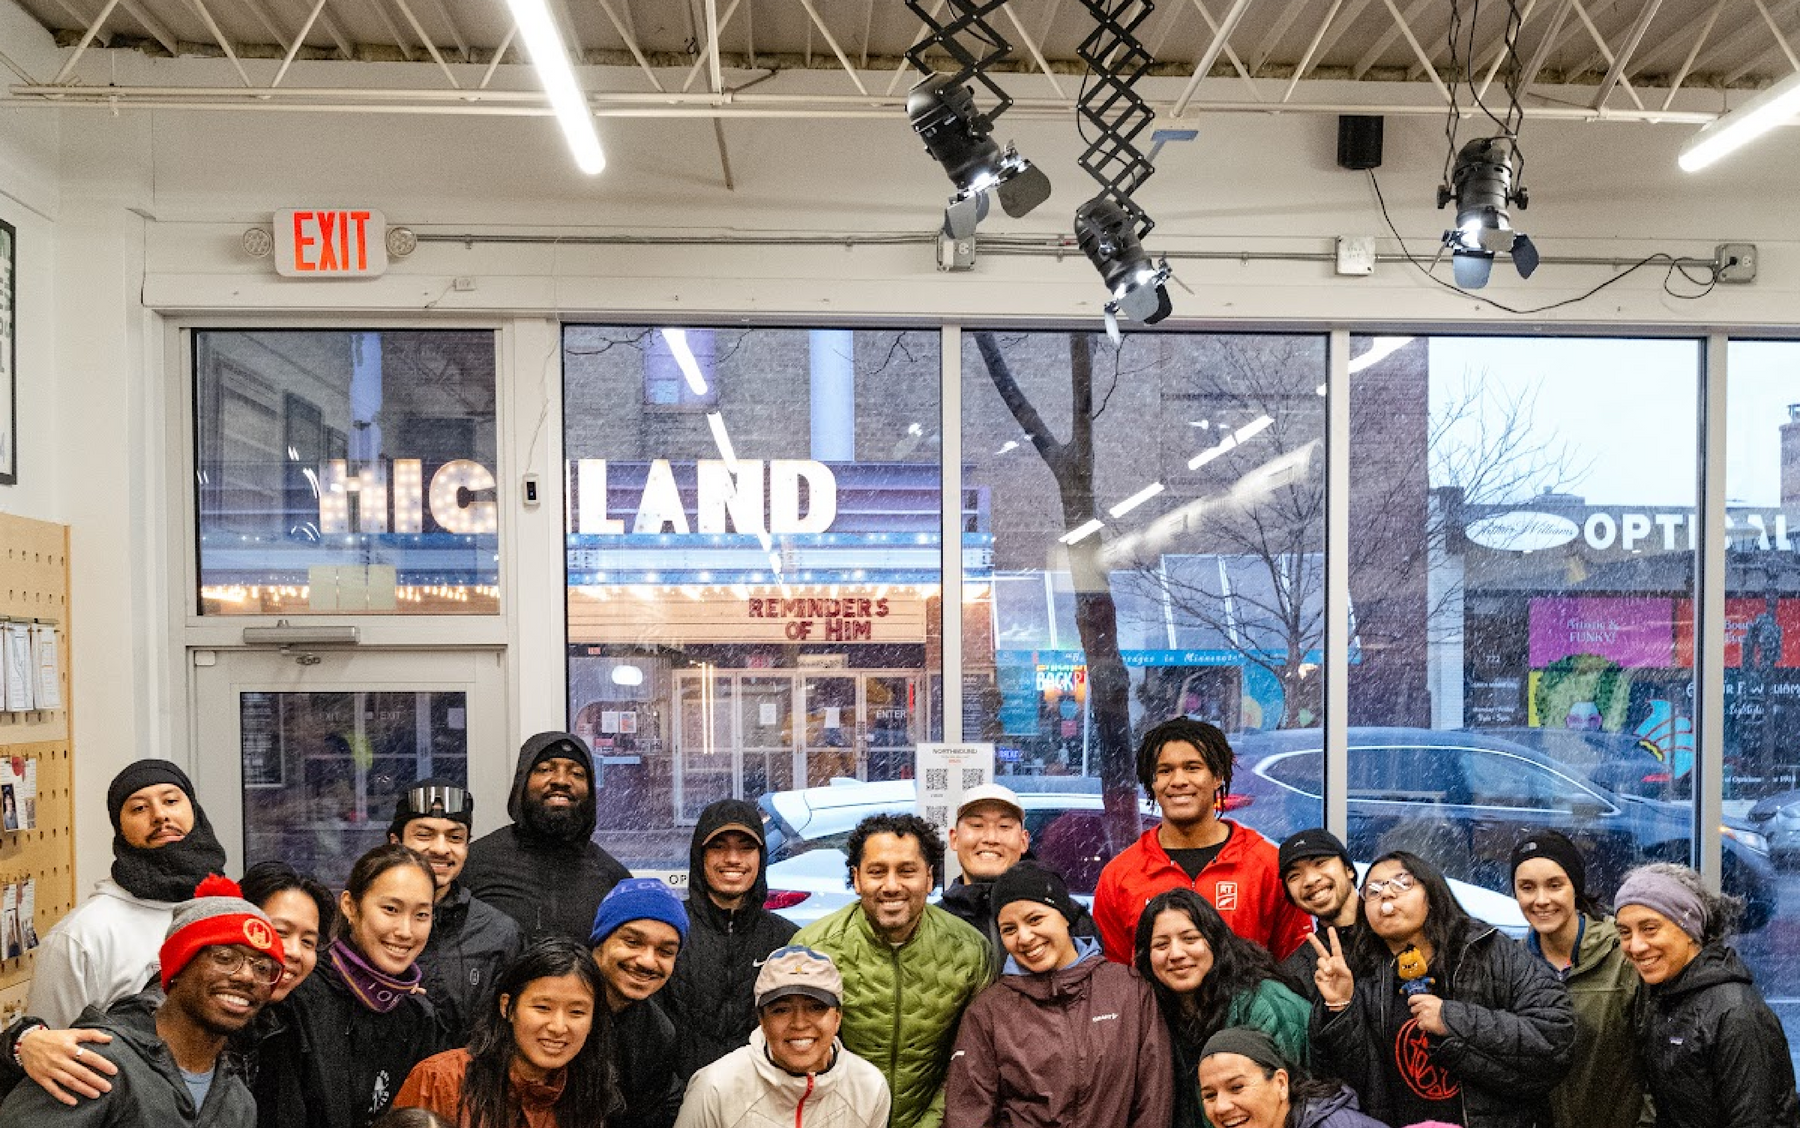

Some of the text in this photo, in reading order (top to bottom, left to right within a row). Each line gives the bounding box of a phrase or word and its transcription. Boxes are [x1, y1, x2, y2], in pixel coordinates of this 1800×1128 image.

[293, 210, 371, 271] EXIT
[319, 458, 838, 535] HIGLAND
[748, 598, 890, 618] REMINDERS
[785, 618, 872, 642] OF HIM
[380, 711, 402, 721] EXIT
[876, 709, 908, 719] ENTER
